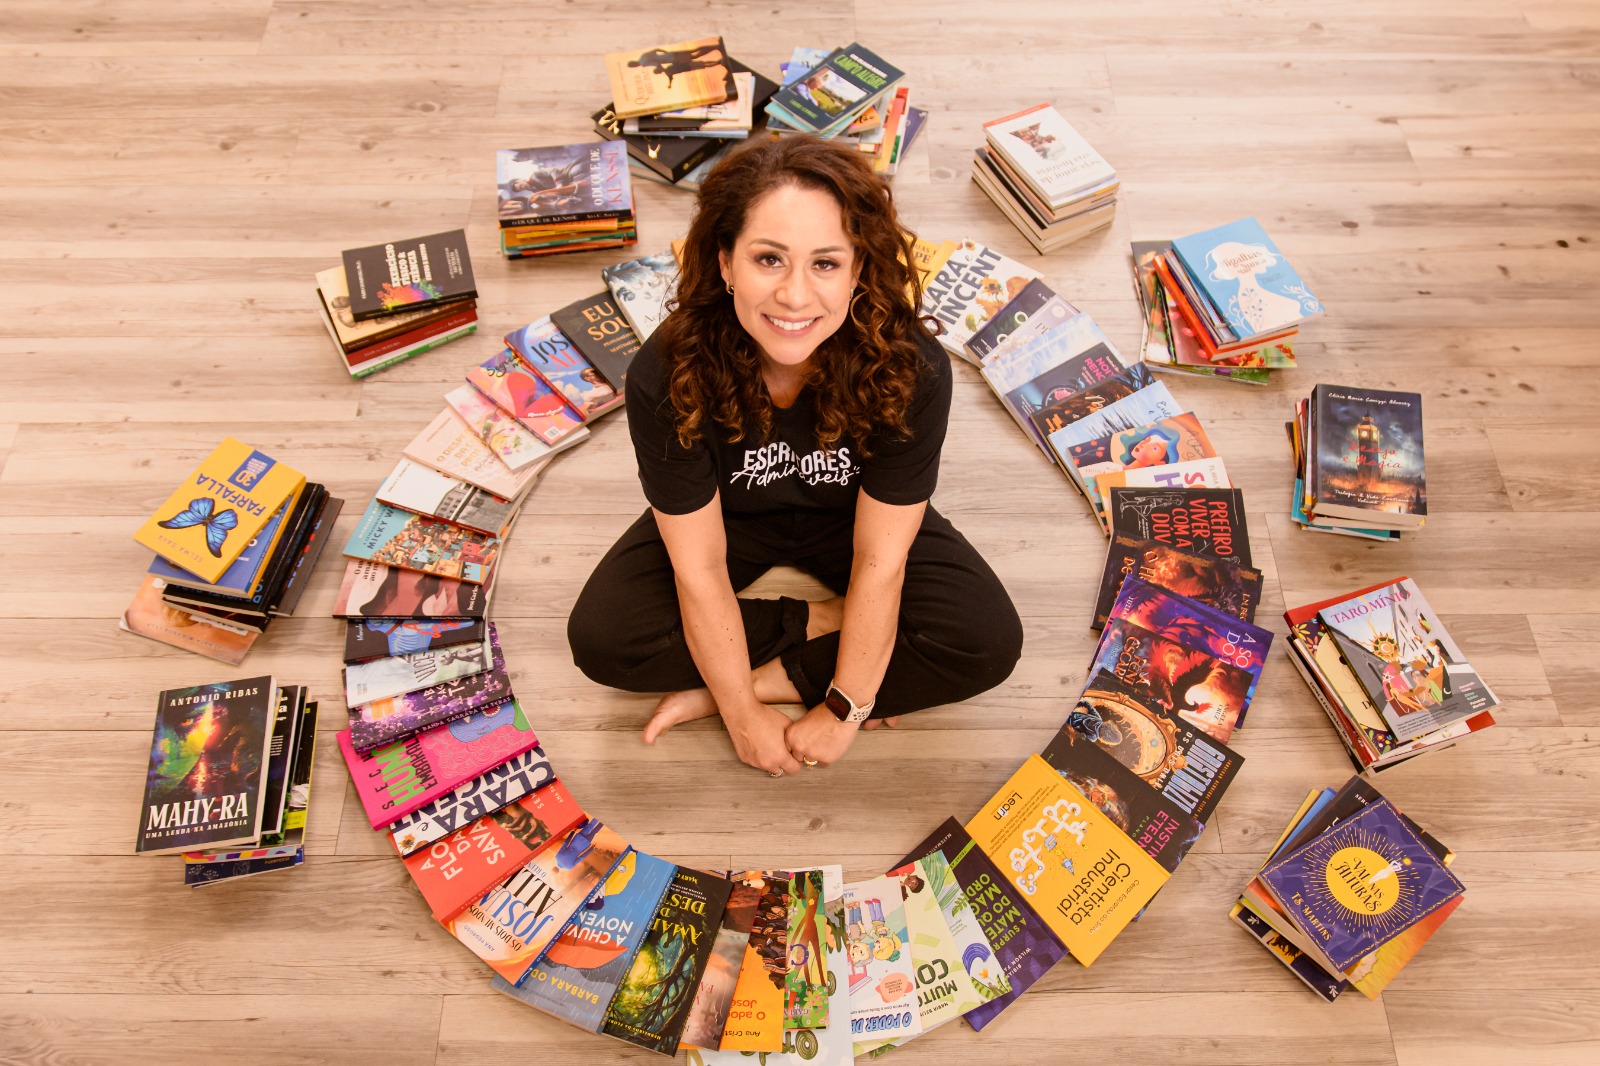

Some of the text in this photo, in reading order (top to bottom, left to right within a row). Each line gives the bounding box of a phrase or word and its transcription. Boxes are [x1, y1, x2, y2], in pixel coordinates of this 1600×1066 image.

[833, 54, 861, 75] CAMPO
[590, 149, 600, 161] DE
[590, 164, 603, 199] DUQUE
[1054, 165, 1080, 180] autor
[581, 302, 614, 323] EU
[531, 335, 569, 364] JOS
[1356, 454, 1405, 472] Magia
[236, 470, 257, 487] 30
[195, 474, 266, 517] FARFALLA
[1171, 508, 1192, 547] COM A
[1189, 499, 1210, 538] VIVER
[1209, 501, 1233, 555] PREFIRO
[1331, 589, 1411, 624] TARO MÍNIO
[1222, 631, 1241, 655] DO
[1244, 632, 1257, 644] A
[170, 687, 258, 707] ANTONIO RIBAS
[446, 707, 478, 723] SAGRADA
[432, 761, 558, 833] CLARA
[993, 792, 1023, 821] Learn
[146, 793, 248, 830] MAHY-RA
[166, 828, 191, 836] LENDA
[207, 820, 248, 831] AMAZÔNIA
[420, 860, 435, 871] A
[1056, 849, 1121, 918] Industrial
[1329, 861, 1382, 913] ALTURAS
[1353, 856, 1385, 900] VAL NAS
[990, 894, 1011, 914] DO
[1070, 862, 1131, 926] Cientista
[633, 930, 648, 954] CHUVA
[649, 876, 676, 920] NOVEMBRO
[1018, 916, 1027, 926] A
[1301, 906, 1332, 941] MARTINS
[492, 924, 512, 943] DOIS
[612, 933, 626, 948] A
[508, 938, 522, 952] OS
[547, 975, 601, 1004] BARBARA
[756, 1011, 766, 1020] O
[934, 1003, 949, 1012] MARIA
[866, 1012, 901, 1032] PODER
[902, 1011, 912, 1027] O
